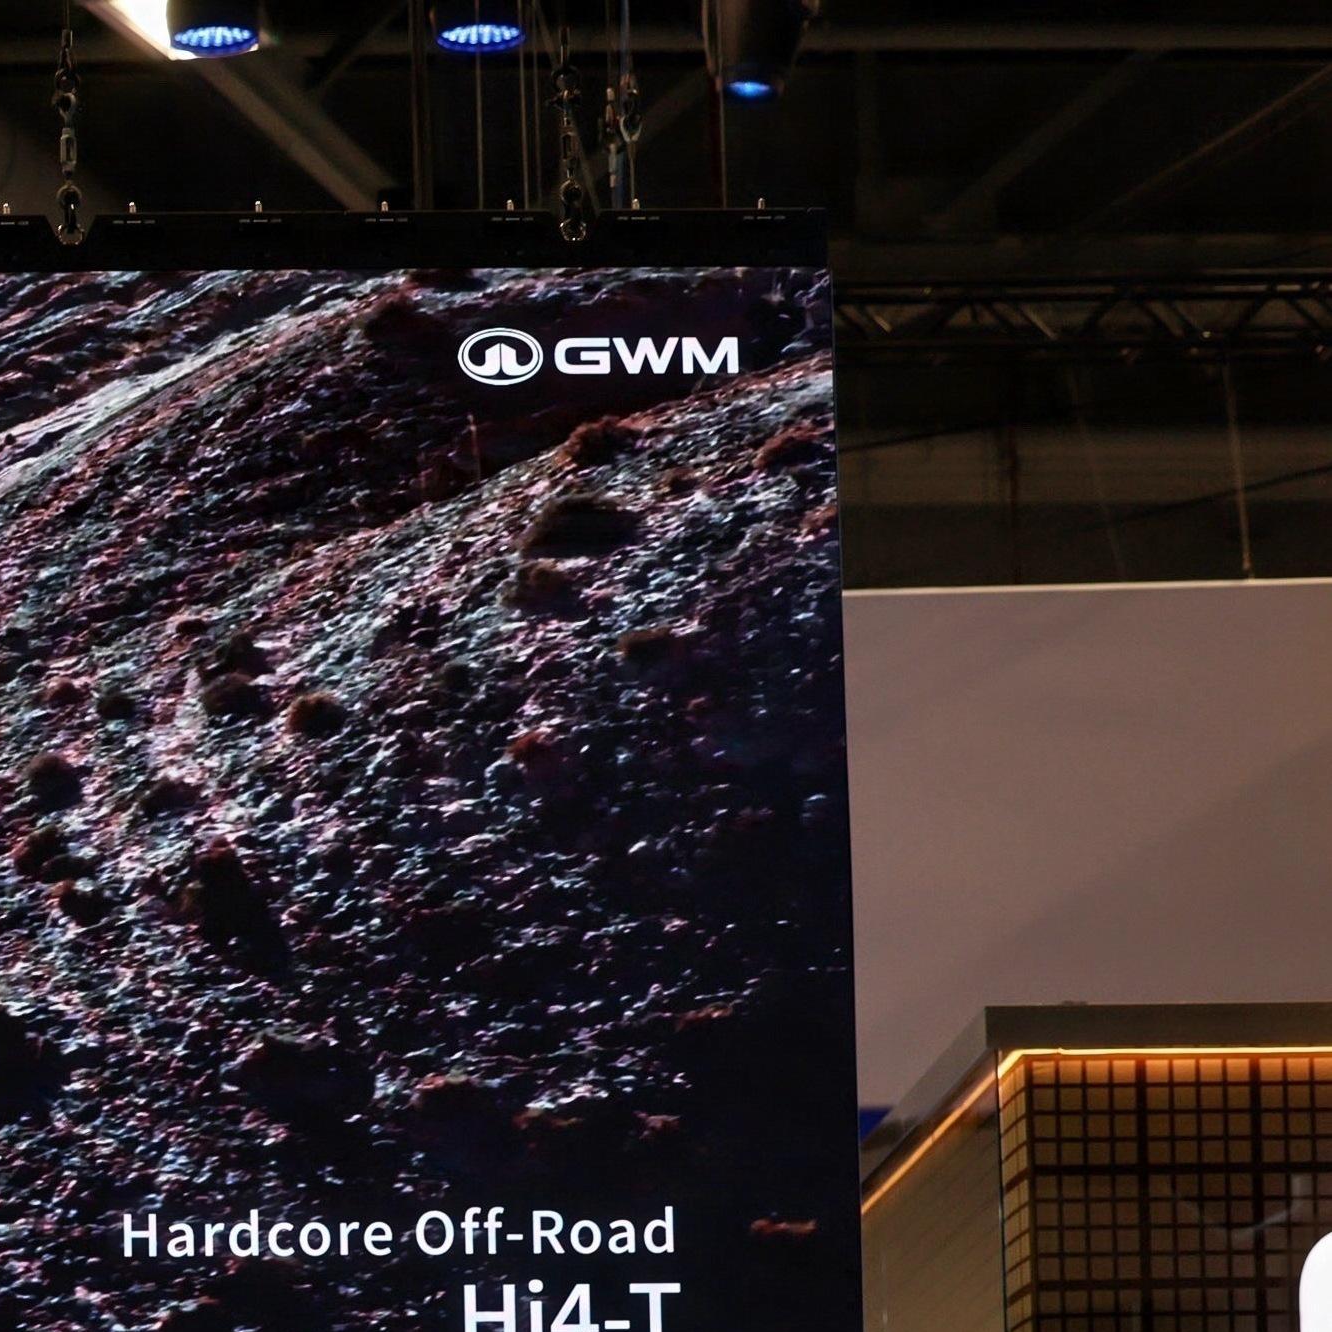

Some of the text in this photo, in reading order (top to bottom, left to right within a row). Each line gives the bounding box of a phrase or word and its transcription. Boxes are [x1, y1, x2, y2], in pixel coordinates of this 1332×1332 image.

[554, 336, 739, 375] GWM
[122, 1205, 677, 1258] Hardcore Off-Road
